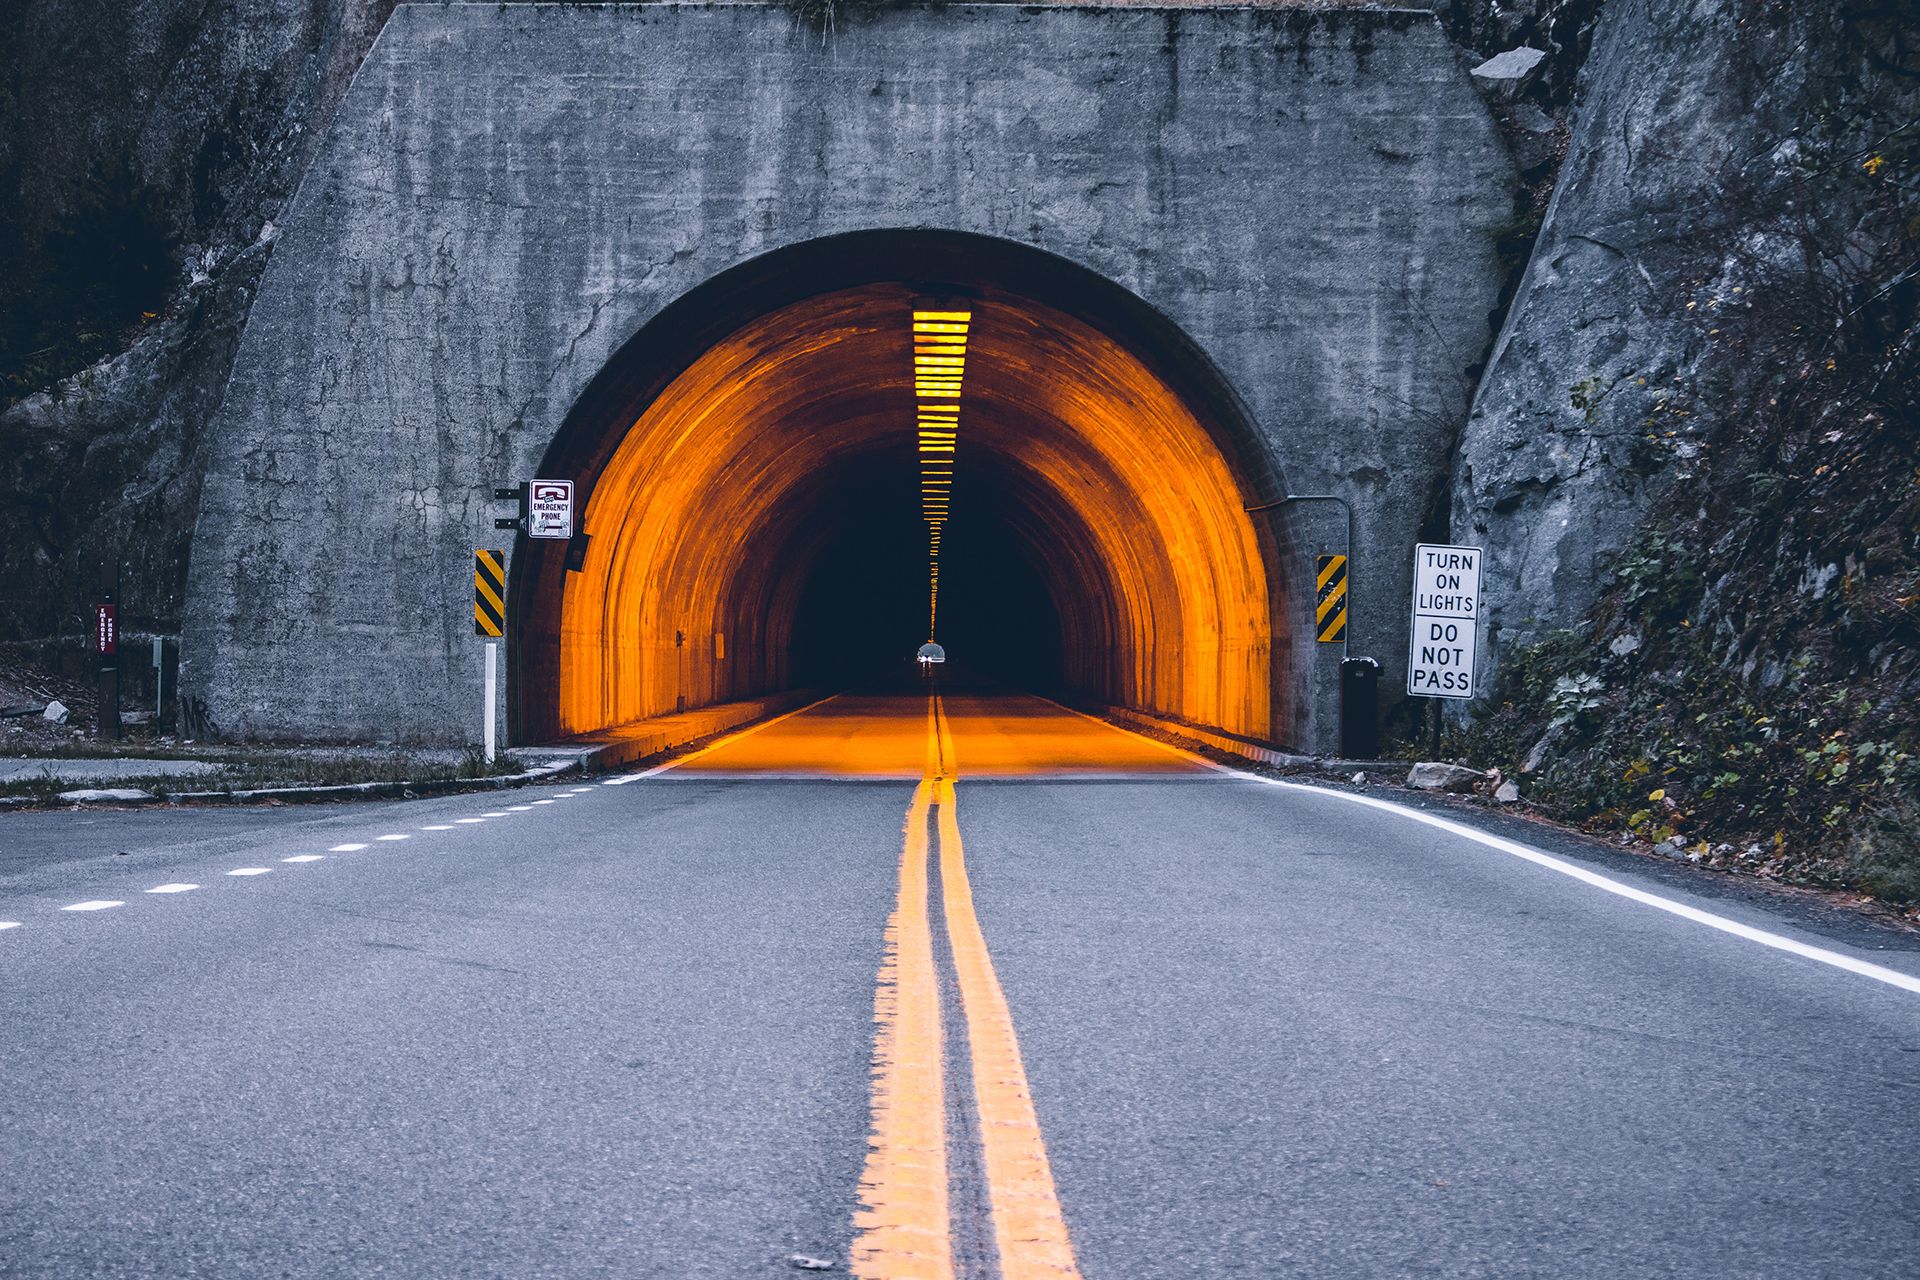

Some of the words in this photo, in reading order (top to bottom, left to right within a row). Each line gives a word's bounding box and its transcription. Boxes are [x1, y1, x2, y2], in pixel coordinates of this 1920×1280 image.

[534, 503, 568, 511] EMERGENCY
[1427, 553, 1473, 570] TURN
[1436, 574, 1460, 590] ON
[1419, 594, 1473, 611] LIGHTS
[1430, 624, 1458, 642] DO
[1422, 647, 1463, 666] NOT
[1413, 670, 1469, 690] PASS
